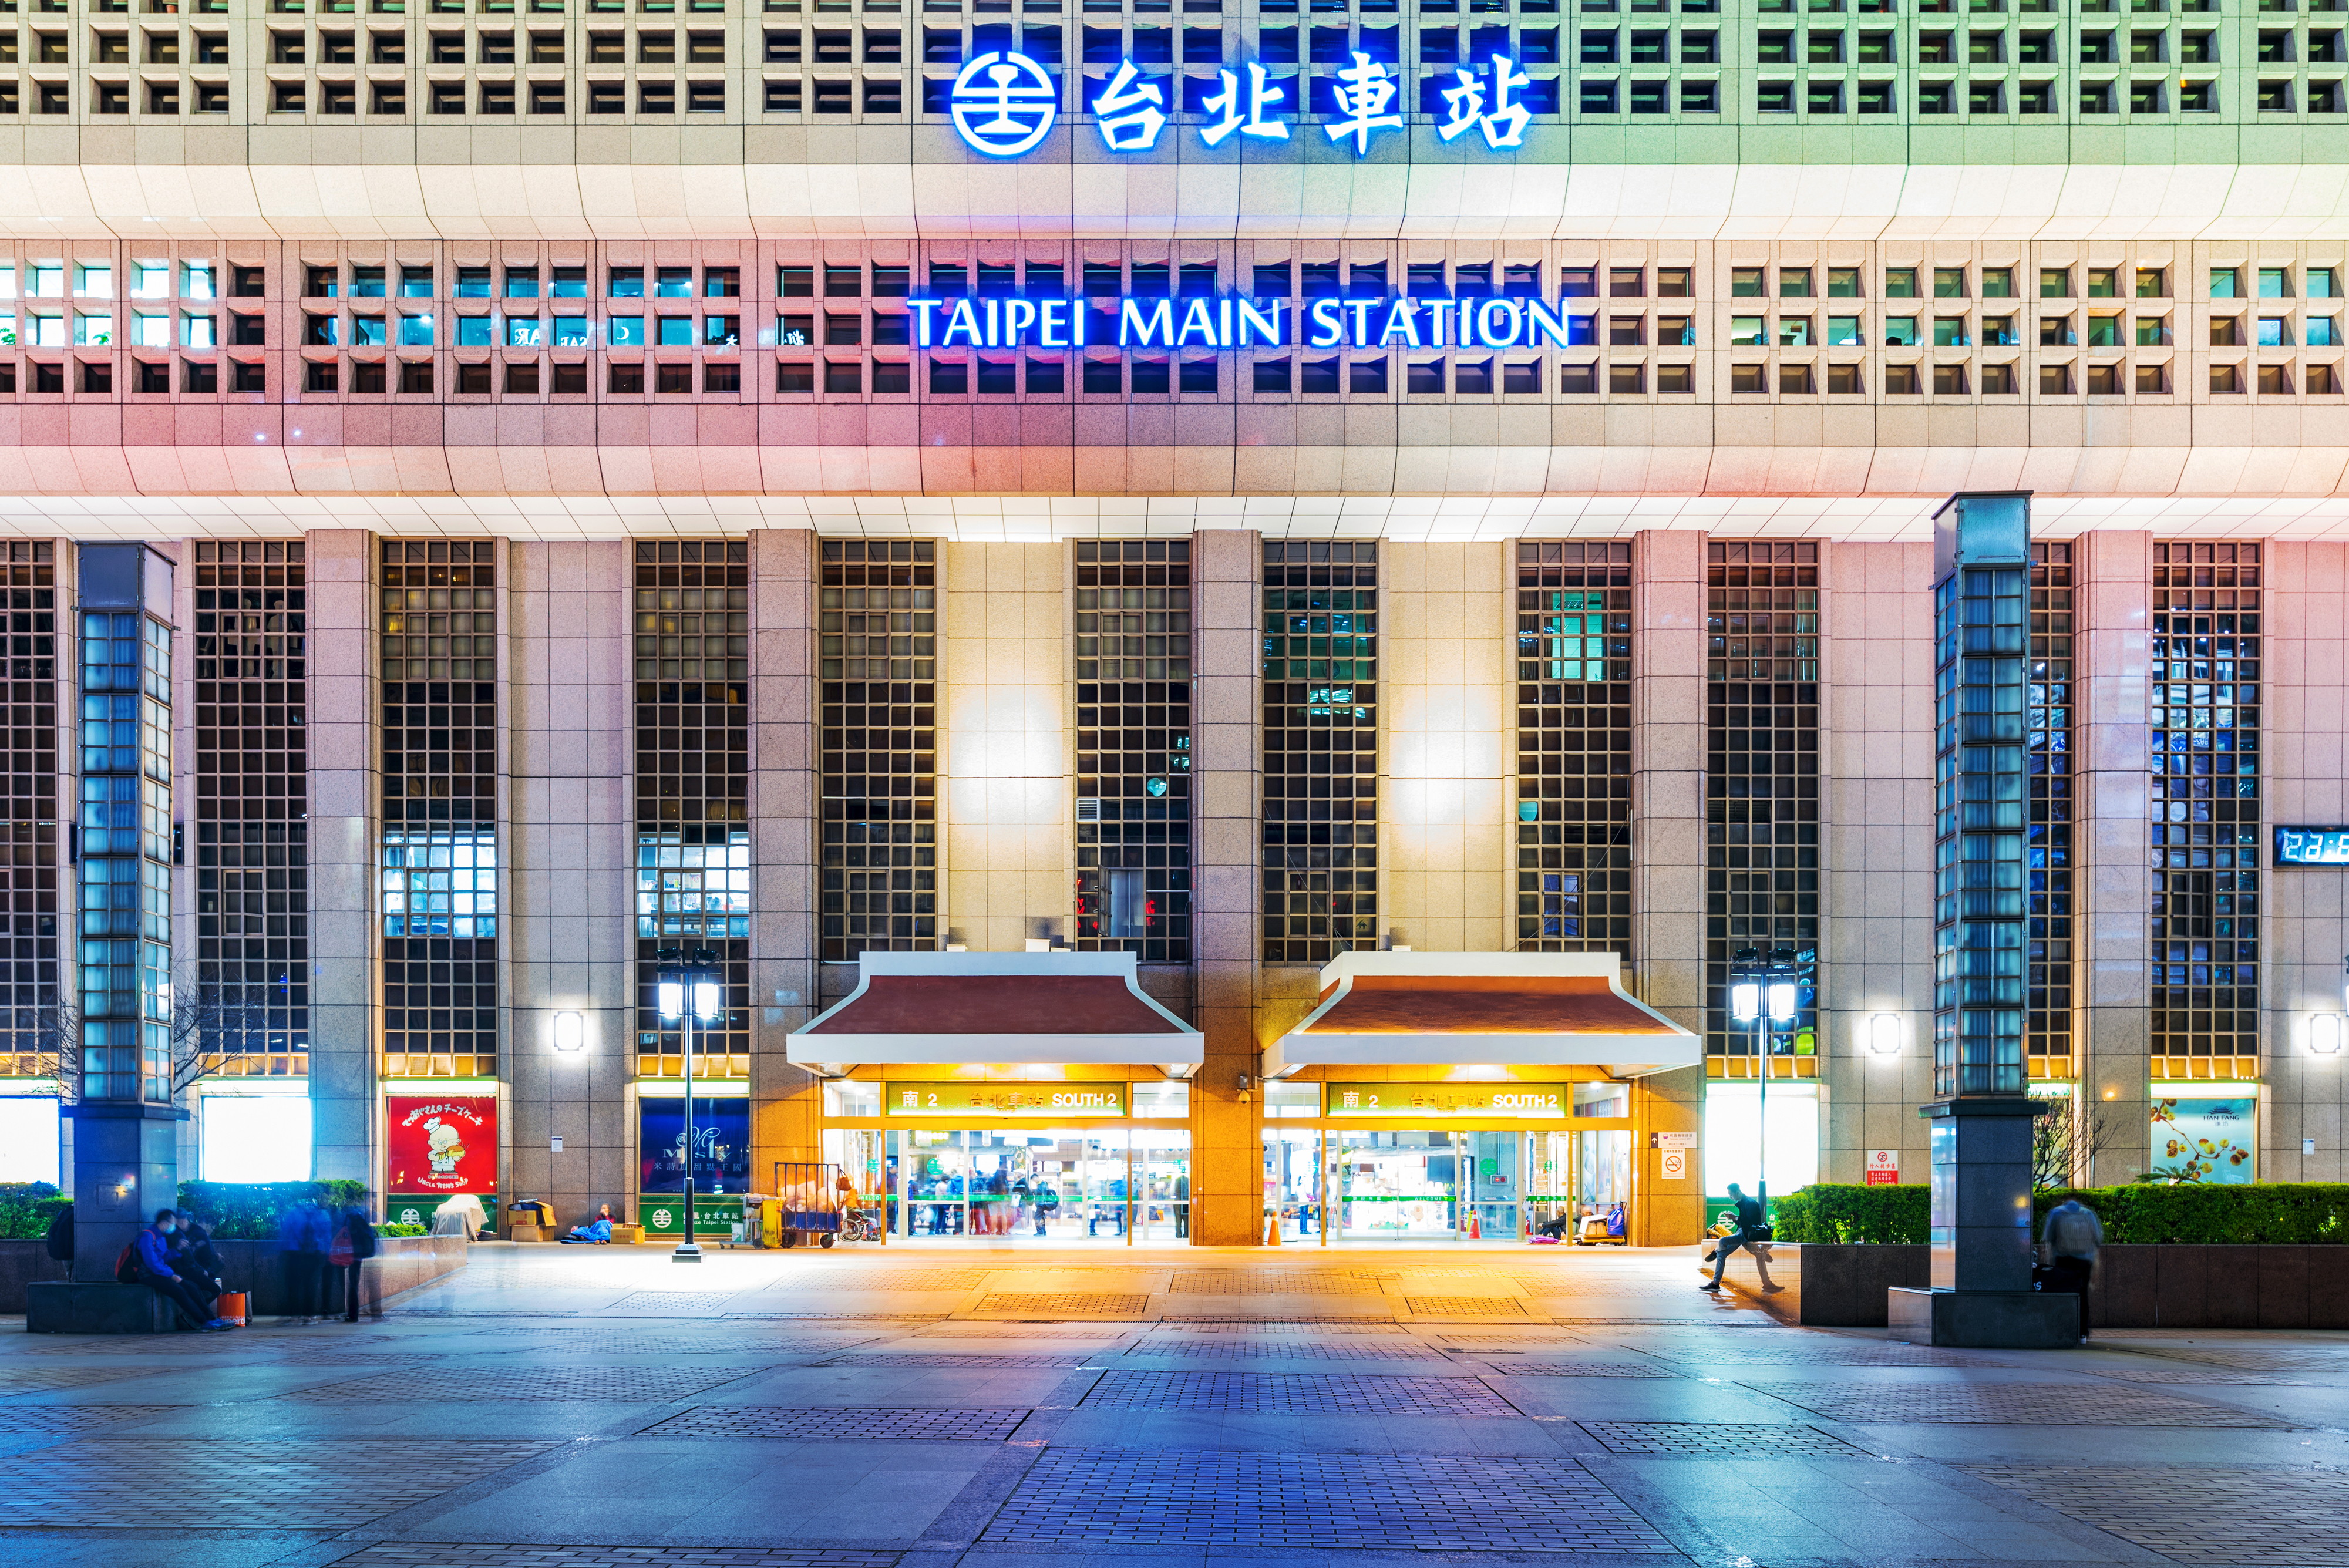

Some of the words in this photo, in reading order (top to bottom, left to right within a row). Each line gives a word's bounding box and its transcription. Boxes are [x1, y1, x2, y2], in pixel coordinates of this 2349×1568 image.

[1092, 51, 1532, 157] 台北車站
[907, 298, 1085, 346] TAIPEI
[1119, 298, 1280, 348] MAIN
[1310, 298, 1570, 349] STATION
[902, 1091, 918, 1107] 南
[928, 1093, 938, 1106] 2
[970, 1092, 1044, 1109] 台北車站
[1052, 1093, 1104, 1107] SOUTH
[1107, 1093, 1117, 1106] 2
[1343, 1091, 1359, 1108] 南
[1369, 1095, 1378, 1108] 2
[1411, 1093, 1485, 1109] 台北車站
[1493, 1094, 1544, 1108] SOUTH
[1548, 1095, 1557, 1108] 2
[445, 1103, 483, 1126] チーズケーキ
